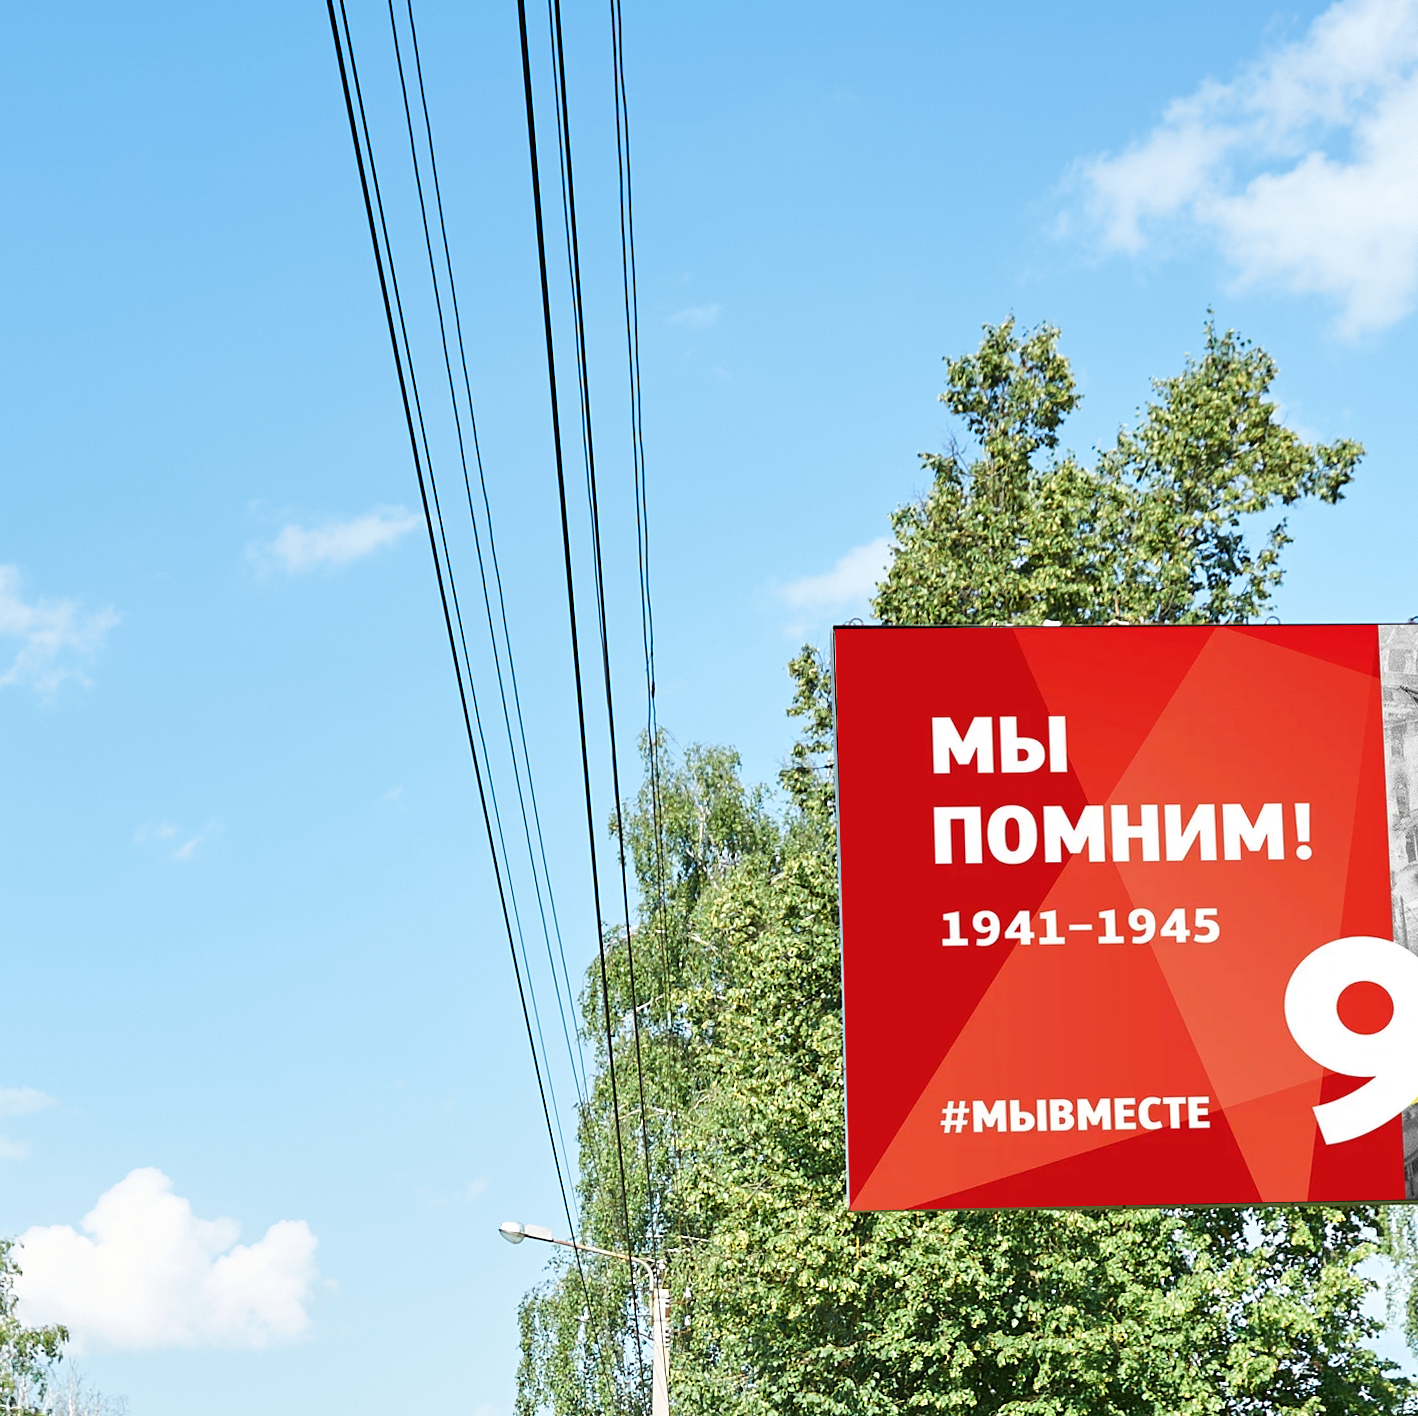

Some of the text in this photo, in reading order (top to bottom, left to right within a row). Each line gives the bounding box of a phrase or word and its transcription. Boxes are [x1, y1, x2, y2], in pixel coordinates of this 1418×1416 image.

[932, 716, 1069, 774] МЫ
[933, 803, 1312, 865] ПОМНИМ!
[940, 1096, 1210, 1134] #МЫВМЕСТЕ
